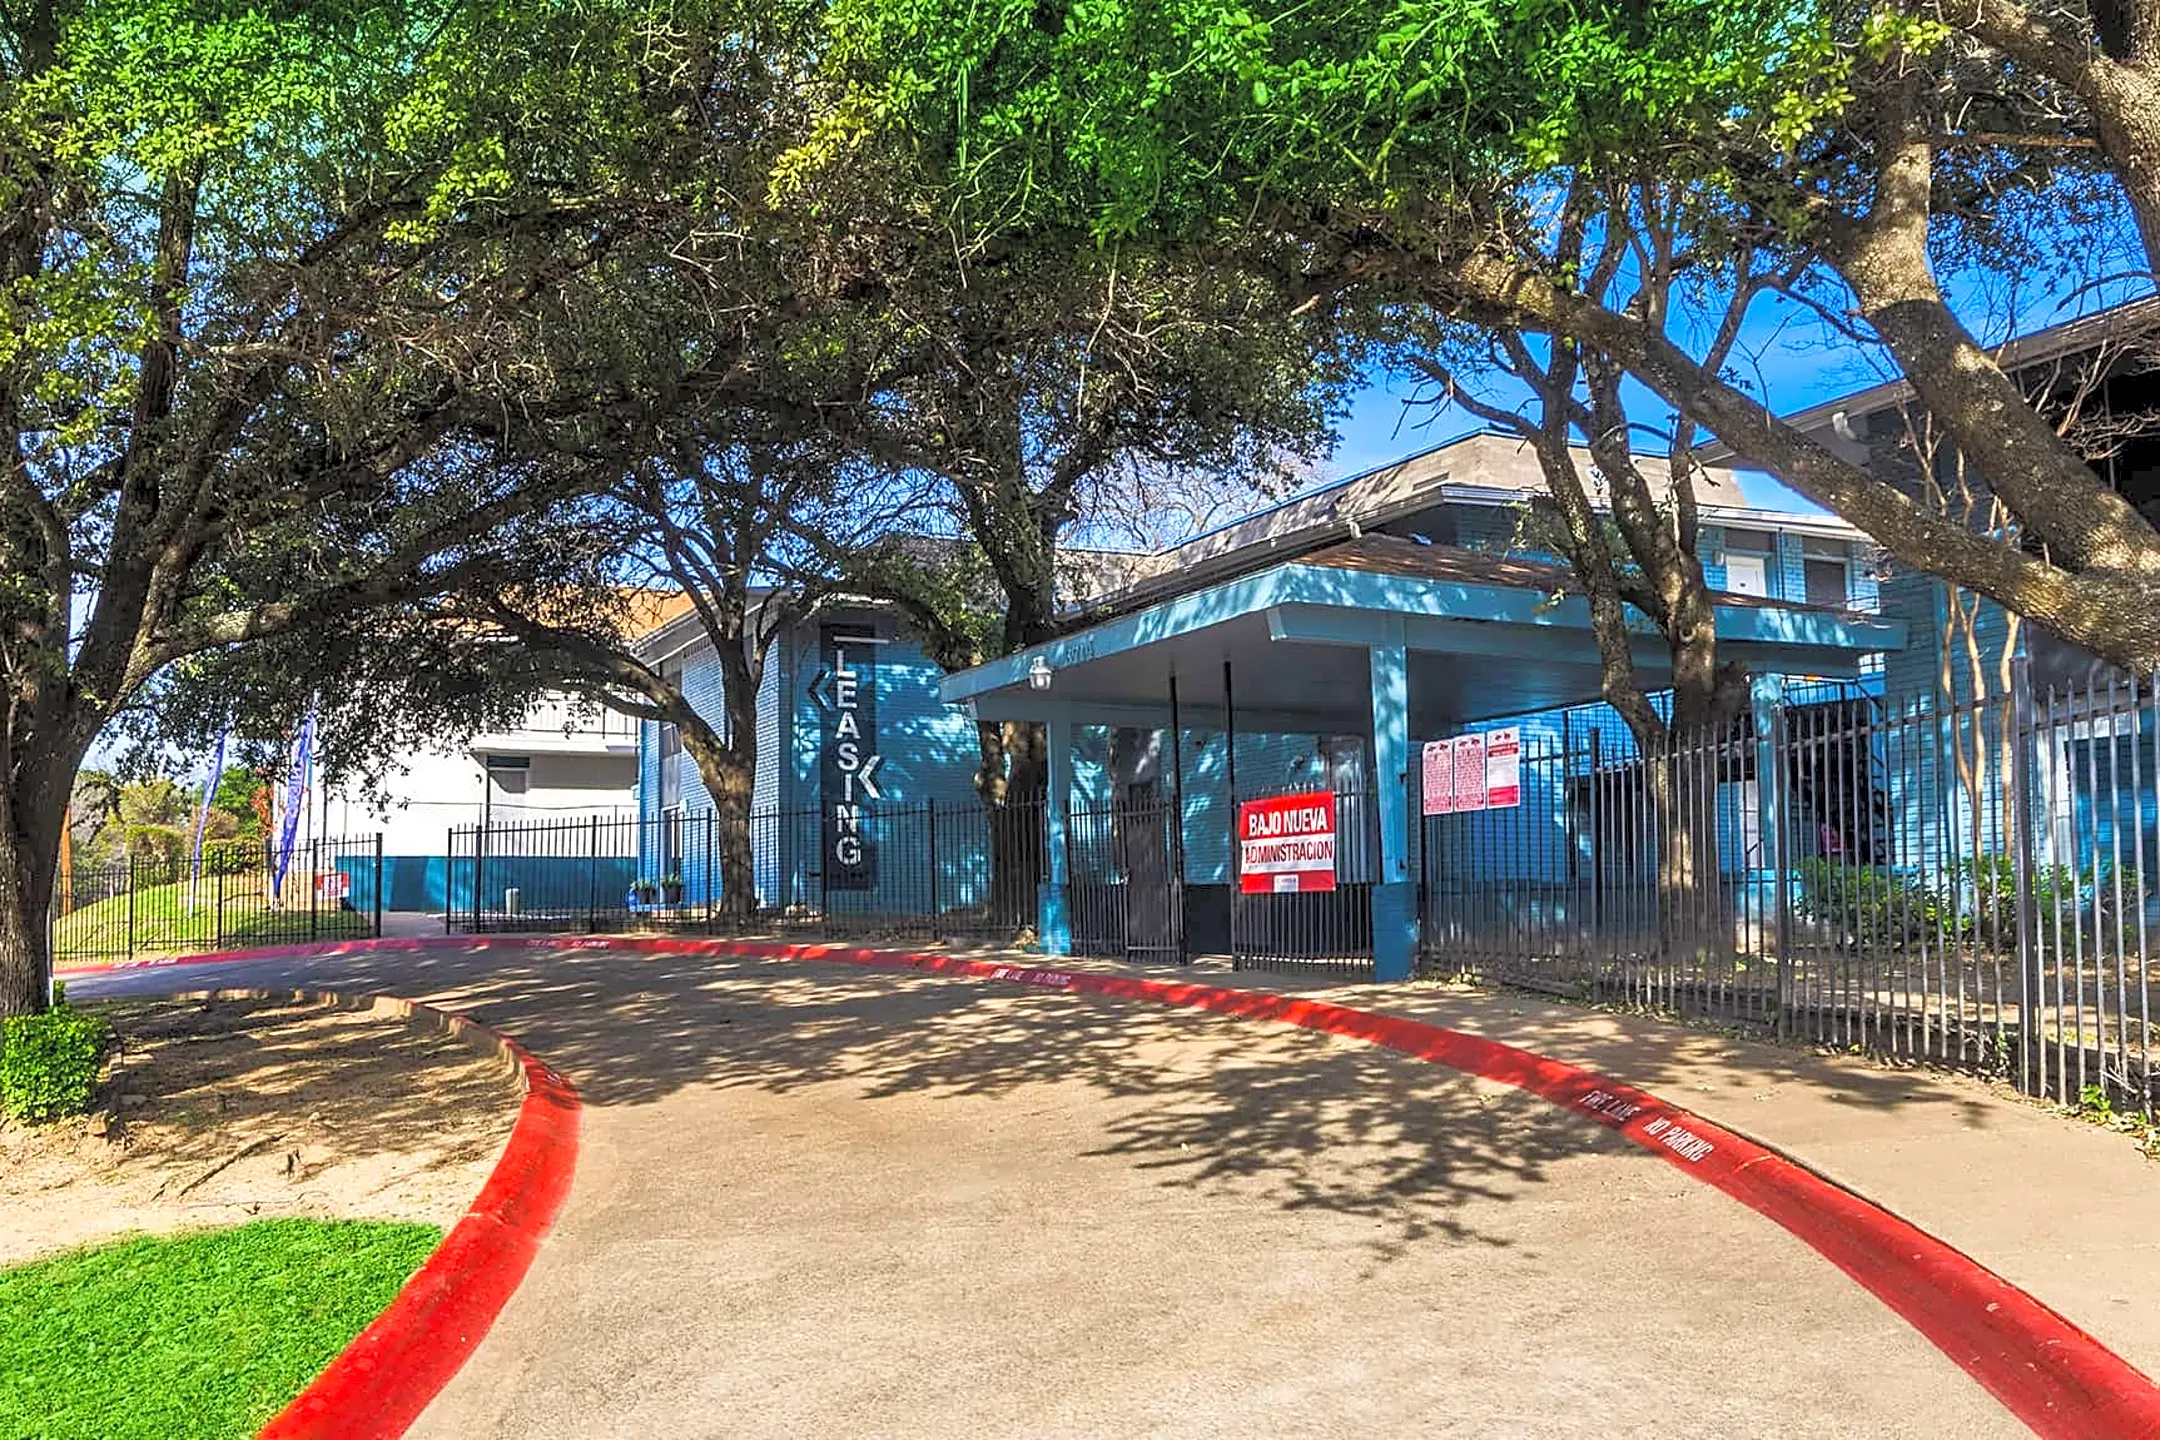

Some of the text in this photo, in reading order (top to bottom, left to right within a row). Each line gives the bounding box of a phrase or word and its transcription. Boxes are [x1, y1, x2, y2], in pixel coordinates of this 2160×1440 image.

[835, 650, 862, 866] LEASING
[1248, 807, 1328, 837] BAJO NUEVA
[1657, 1126, 1716, 1162] PARKING
